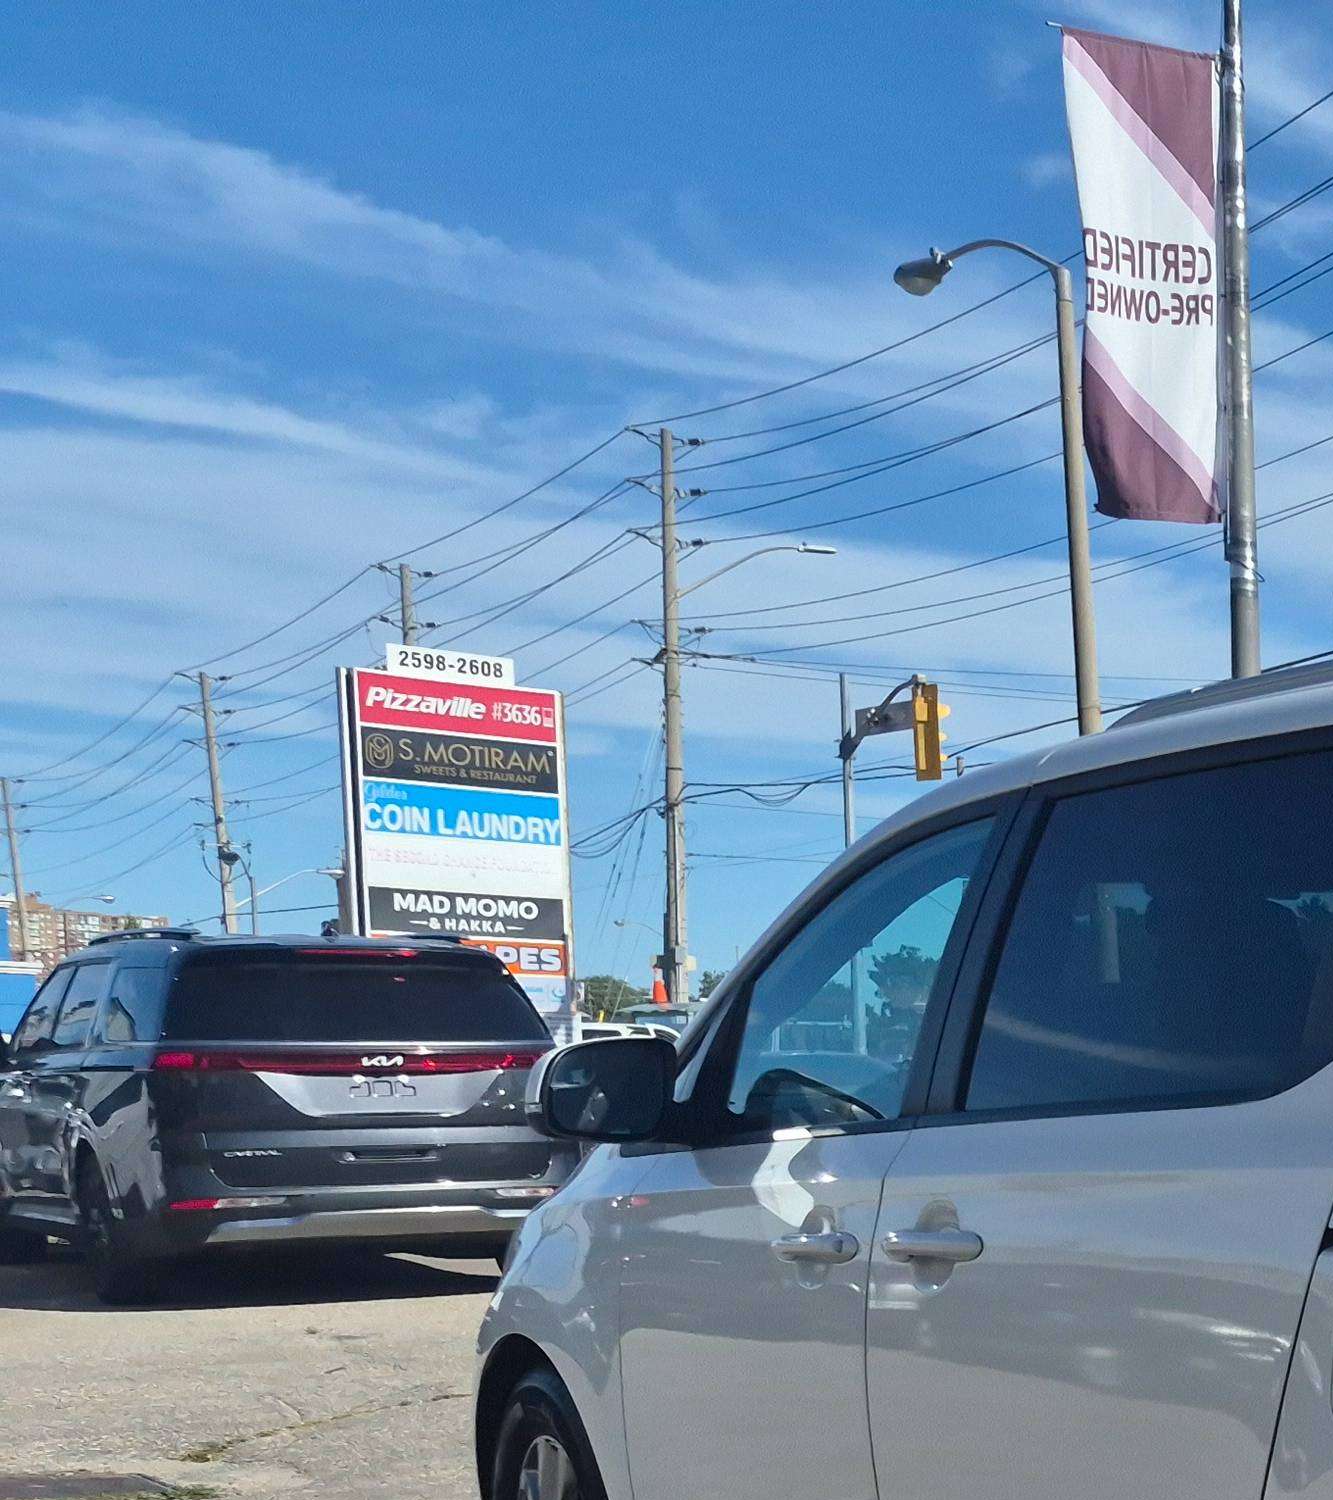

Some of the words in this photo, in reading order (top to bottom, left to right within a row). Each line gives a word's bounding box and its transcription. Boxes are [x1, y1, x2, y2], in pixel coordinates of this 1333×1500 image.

[398, 650, 504, 679] 2598-2608
[364, 685, 487, 720] Pizzaville
[423, 741, 551, 775] MOTIRAM
[413, 763, 458, 778] SWEETS
[470, 768, 537, 785] RESTAURANT
[364, 802, 431, 834] COIN
[436, 808, 561, 845] LAUNDRY
[392, 892, 451, 914] MAD
[455, 896, 539, 921] MOMO
[428, 917, 441, 930] &
[444, 918, 506, 934] HAKKA
[480, 944, 562, 972] PES
